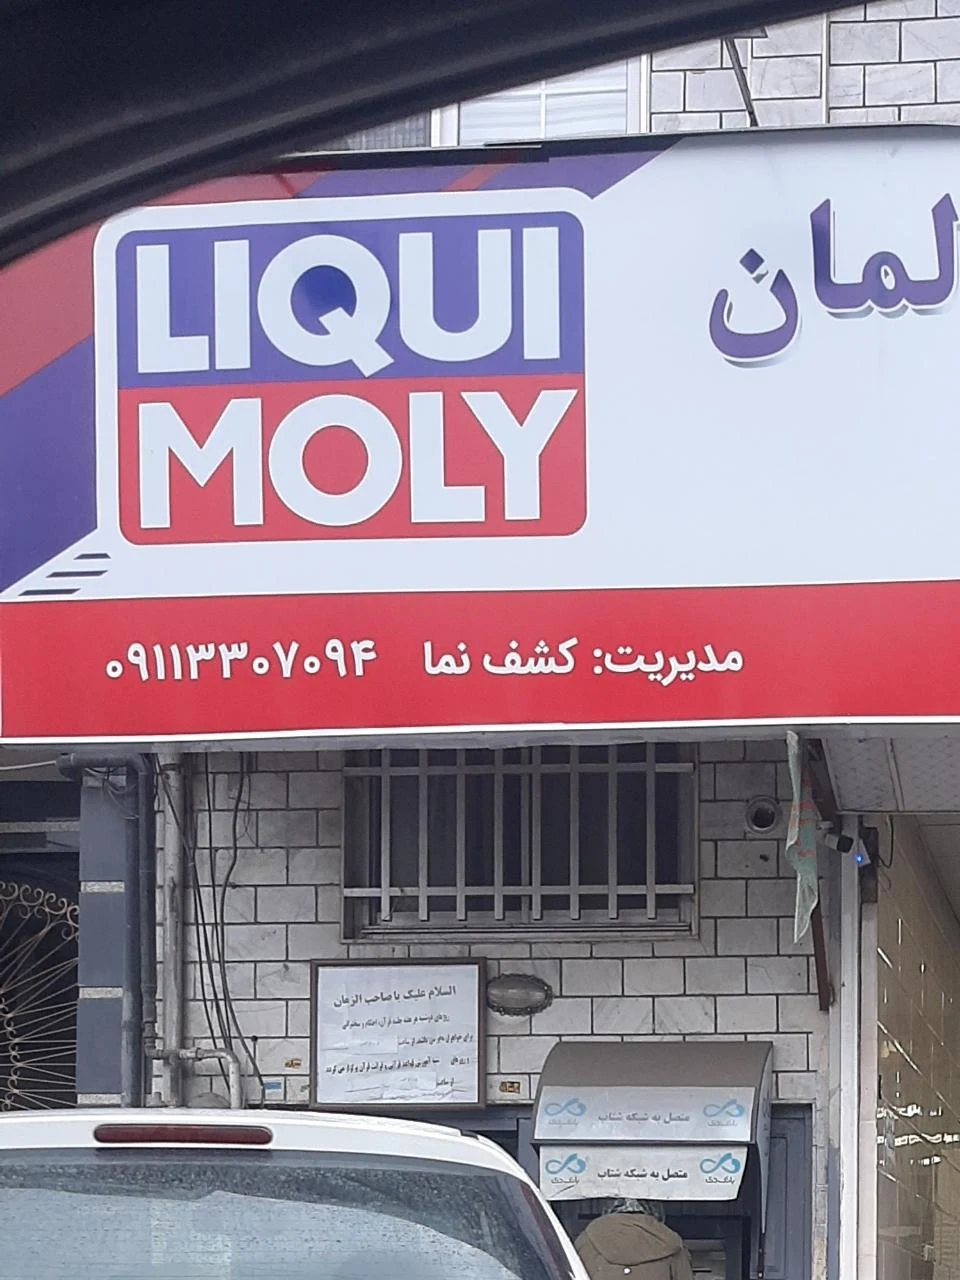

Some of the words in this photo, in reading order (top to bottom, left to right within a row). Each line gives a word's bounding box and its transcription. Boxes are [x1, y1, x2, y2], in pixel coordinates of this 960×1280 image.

[135, 226, 561, 378] LIQUI
[138, 388, 579, 530] MOLY
[105, 638, 377, 682] ۰۹۱۱۳۳۰۷۰۹۴
[423, 640, 471, 675] نما
[483, 637, 578, 675] کشف
[593, 643, 744, 686] مدیریت:
[625, 1112, 650, 1124] شبکه
[663, 1112, 690, 1124] متصل
[597, 1168, 622, 1181] شتاب
[623, 1167, 648, 1181] شبکه
[650, 1170, 660, 1181] به
[661, 1167, 688, 1181] متصل
